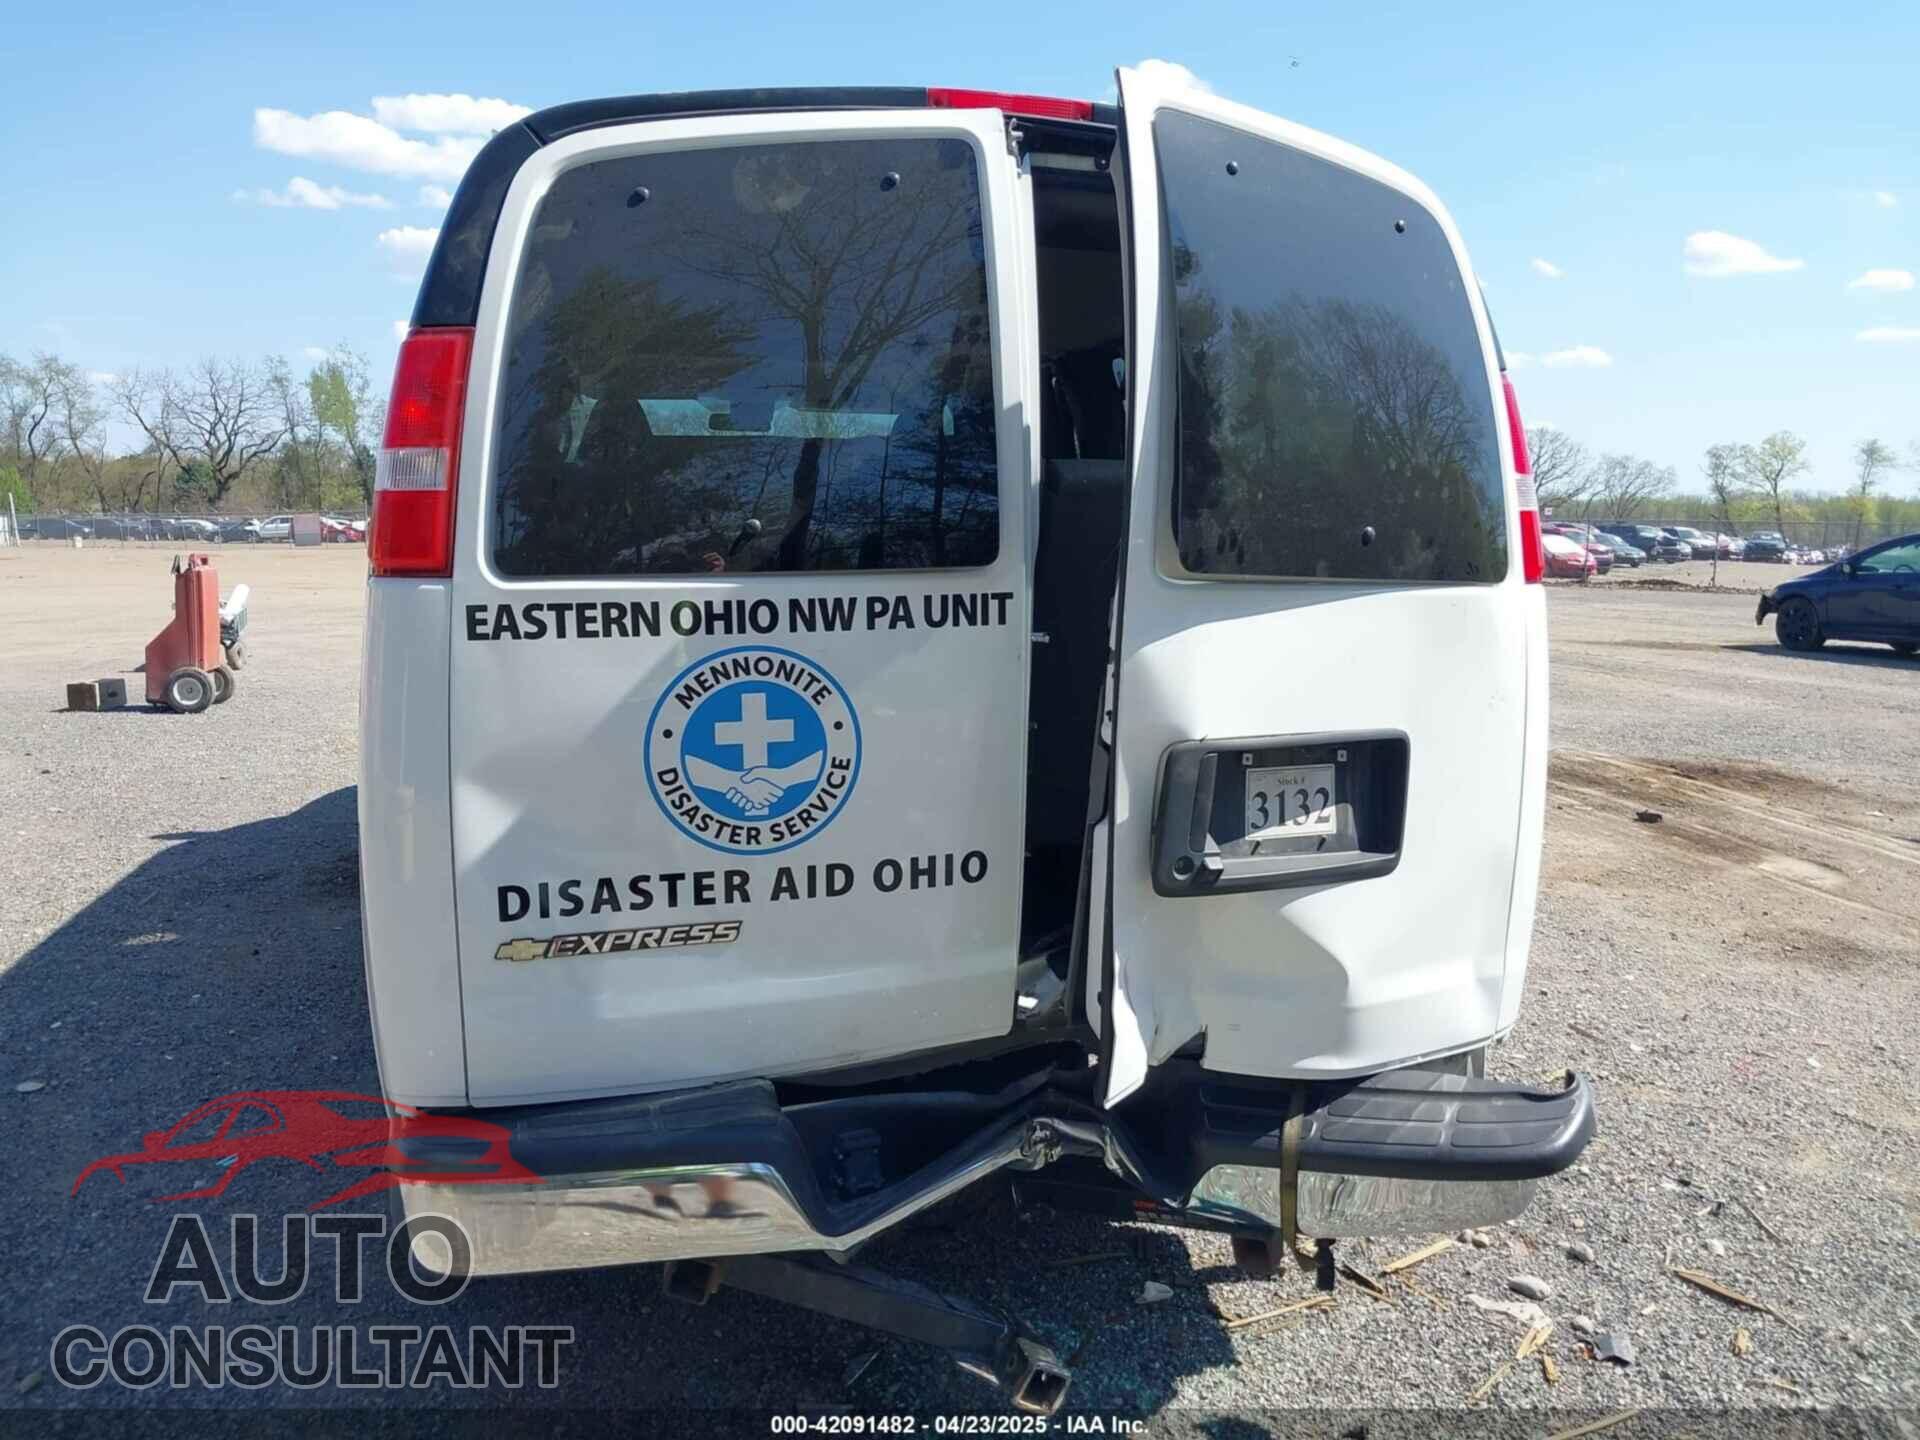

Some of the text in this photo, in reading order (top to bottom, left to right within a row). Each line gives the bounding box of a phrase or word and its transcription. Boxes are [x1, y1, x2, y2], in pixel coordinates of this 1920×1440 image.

[466, 592, 1014, 641] EASTERN OHIO NW PA UNIT
[673, 655, 834, 710] MENNONITE
[656, 755, 853, 846] DISASTER SERVICE
[1250, 787, 1330, 829] 3132
[497, 850, 990, 922] DISASTER AID OHIO
[549, 922, 741, 957] EXPRESS
